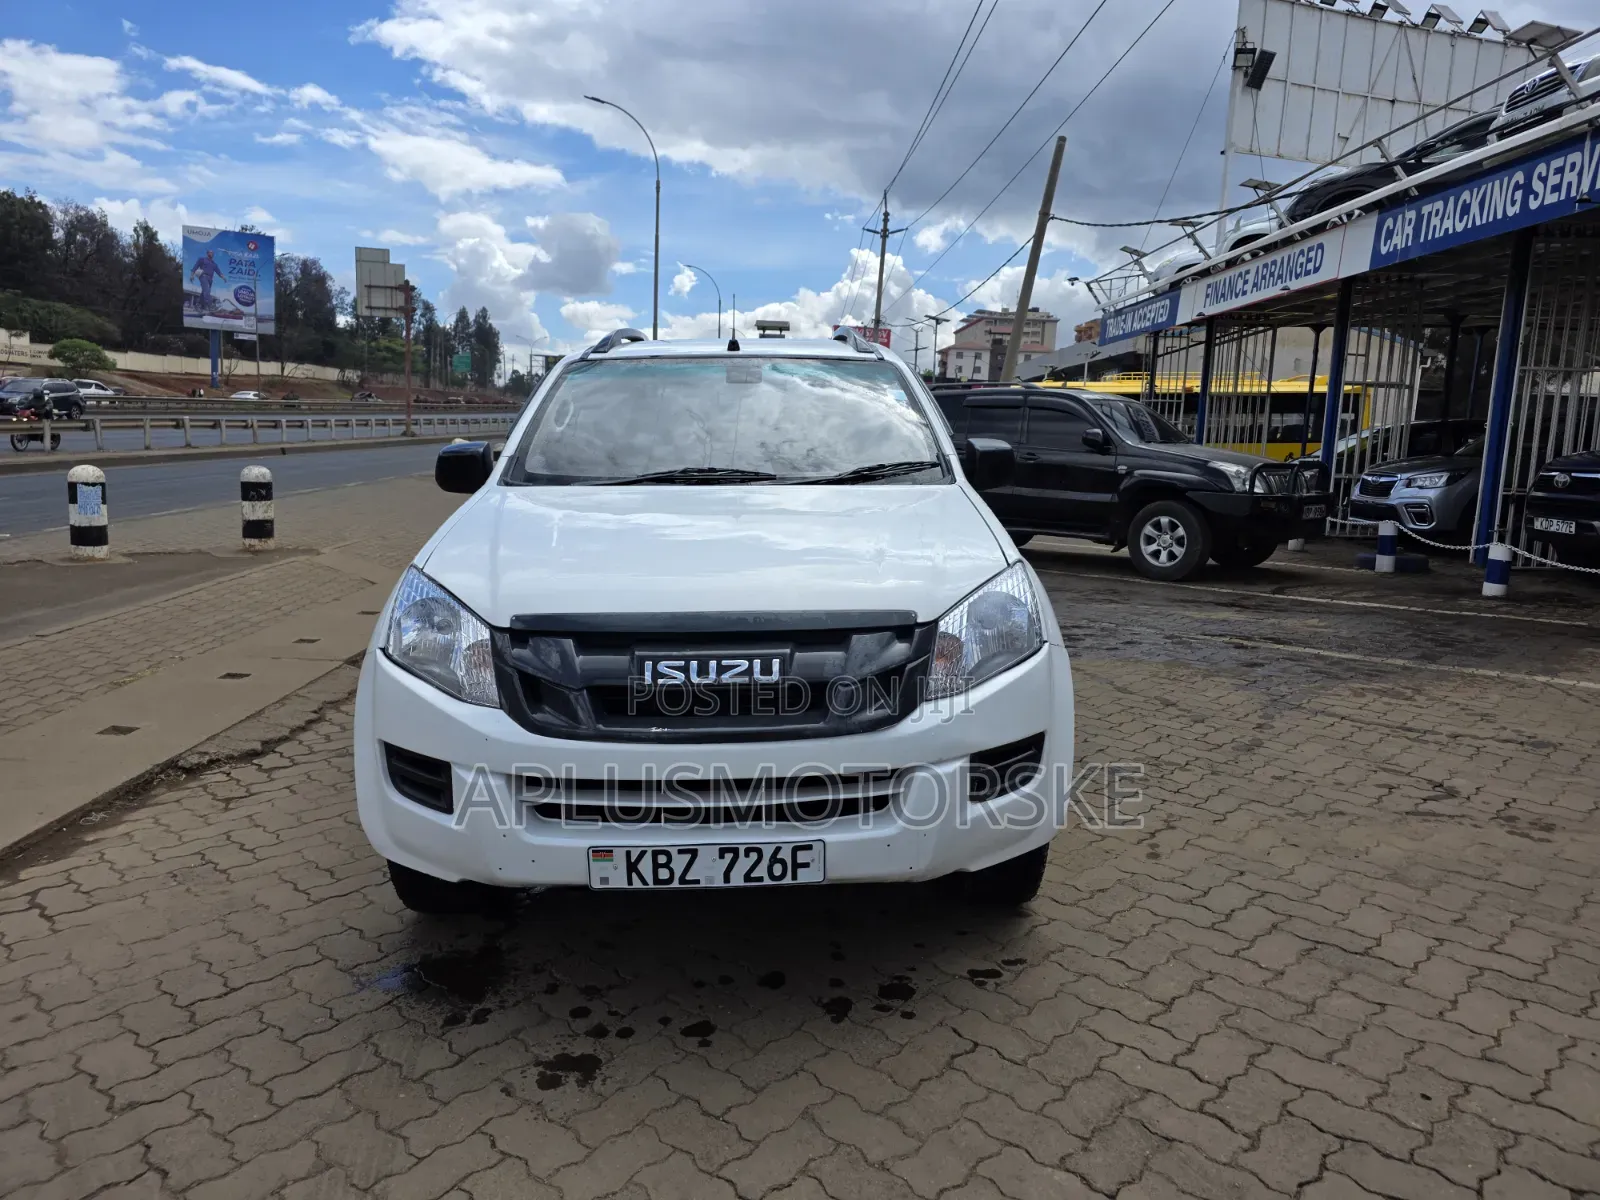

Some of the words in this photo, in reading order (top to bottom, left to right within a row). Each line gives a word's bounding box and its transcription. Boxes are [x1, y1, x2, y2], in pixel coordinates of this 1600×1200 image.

[1380, 209, 1416, 255] CAR
[1419, 170, 1525, 243] TRACKING
[228, 258, 256, 268] PATA
[1203, 268, 1250, 308] FINANCE
[1250, 242, 1325, 294] ARRANGED
[1106, 313, 1133, 338] TRADE-IN
[1131, 299, 1170, 331] ACCEPTED
[644, 658, 780, 684] ISUZU
[625, 848, 700, 886] KBZ
[718, 844, 813, 884] 726F
